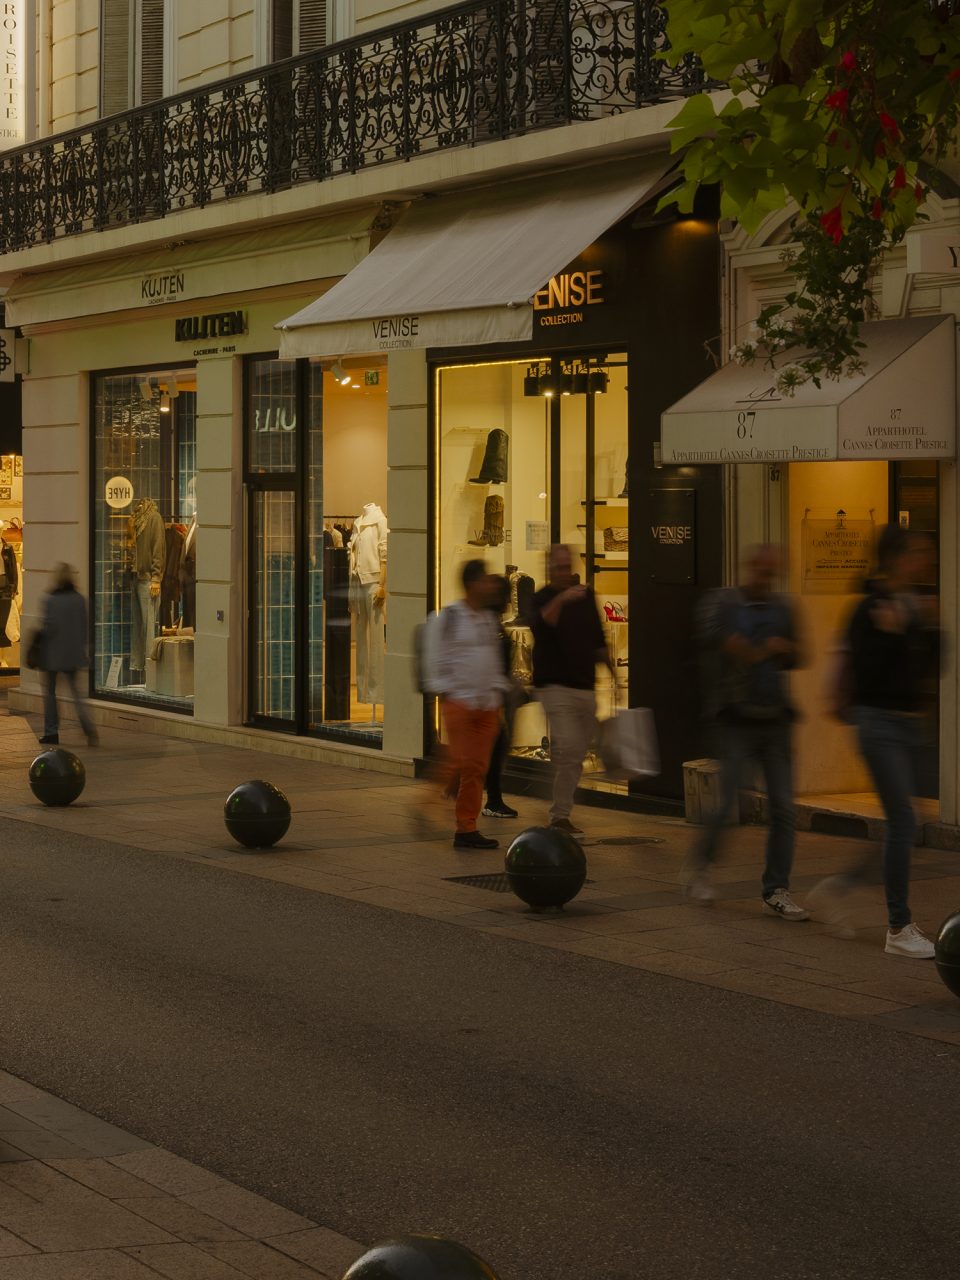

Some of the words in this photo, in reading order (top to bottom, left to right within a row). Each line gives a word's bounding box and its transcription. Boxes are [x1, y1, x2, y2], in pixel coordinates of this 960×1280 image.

[141, 273, 184, 298] KUJTEN
[534, 270, 604, 310] ENISE
[175, 310, 248, 342] KUJTEN
[540, 312, 583, 326] COLLECTION
[372, 317, 419, 338] VENISE
[890, 408, 902, 420] 87
[736, 411, 756, 440] 87
[866, 425, 926, 436] APPARTHOTEL
[843, 438, 873, 450] CANNES
[875, 438, 912, 450] CROISETTE
[915, 437, 948, 449] PRESTIGE
[671, 449, 720, 461] APPARTHOTEL
[720, 448, 750, 460] CANNES
[750, 447, 789, 459] CROISETTE
[792, 445, 829, 459] PRESTIGE
[770, 470, 780, 482] 87
[650, 526, 692, 539] VENISE
